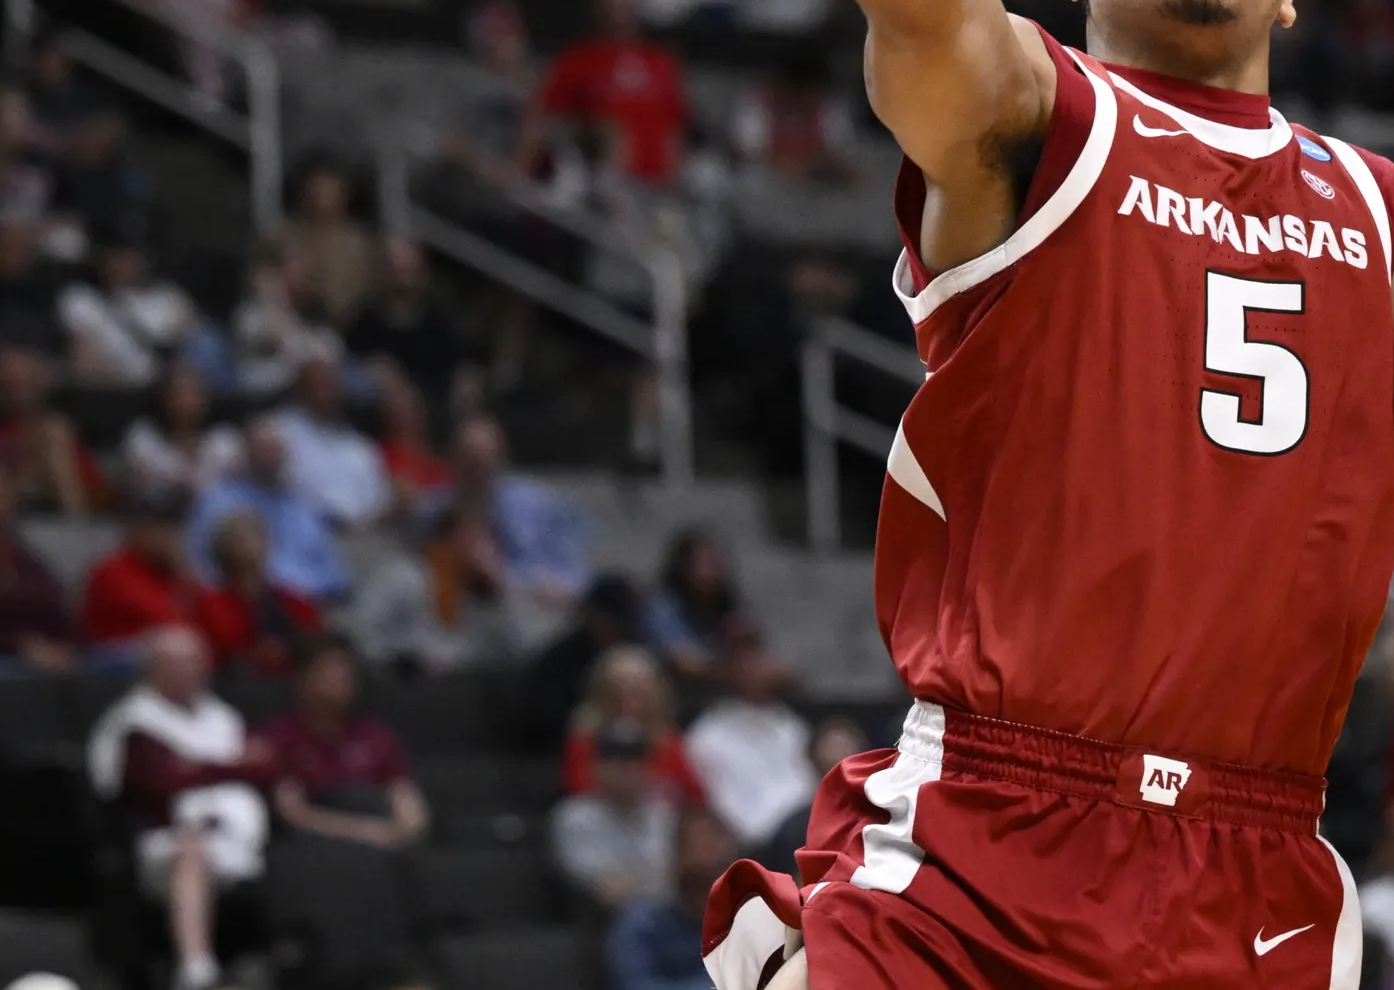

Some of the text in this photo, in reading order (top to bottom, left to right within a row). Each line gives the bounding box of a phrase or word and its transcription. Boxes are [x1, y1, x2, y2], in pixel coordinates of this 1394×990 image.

[1117, 174, 1369, 270] ARKANSAS
[1200, 268, 1310, 455] 5
[1147, 768, 1182, 792] AR
